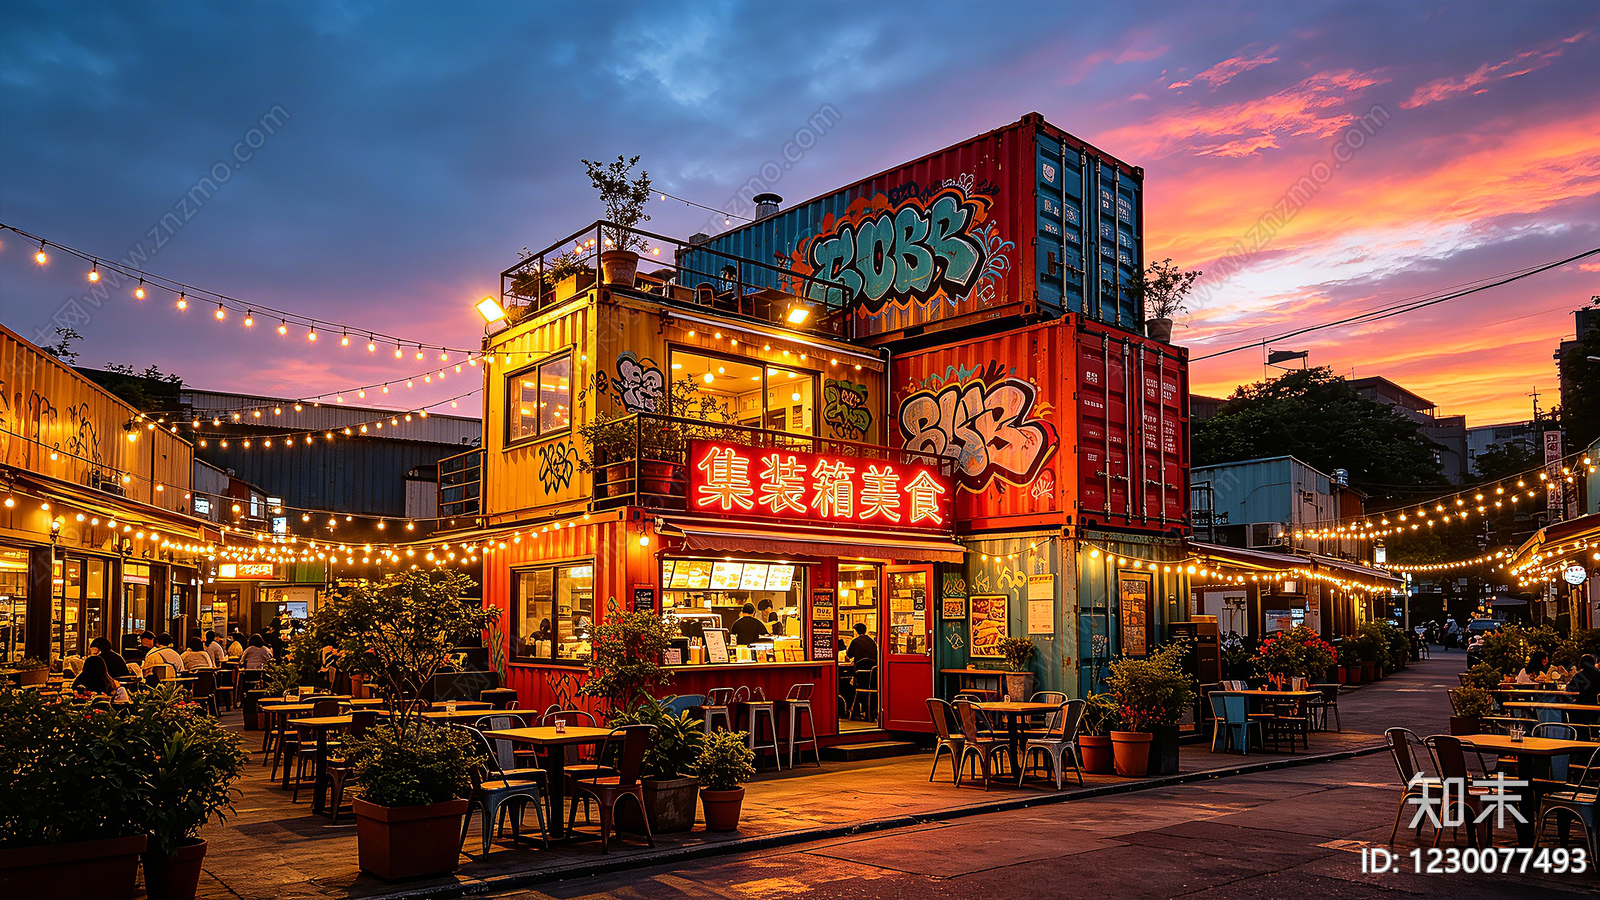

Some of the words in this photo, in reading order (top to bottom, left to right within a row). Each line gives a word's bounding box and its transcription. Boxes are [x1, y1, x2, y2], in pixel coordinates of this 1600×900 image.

[697, 446, 945, 525] 集装箱美食
